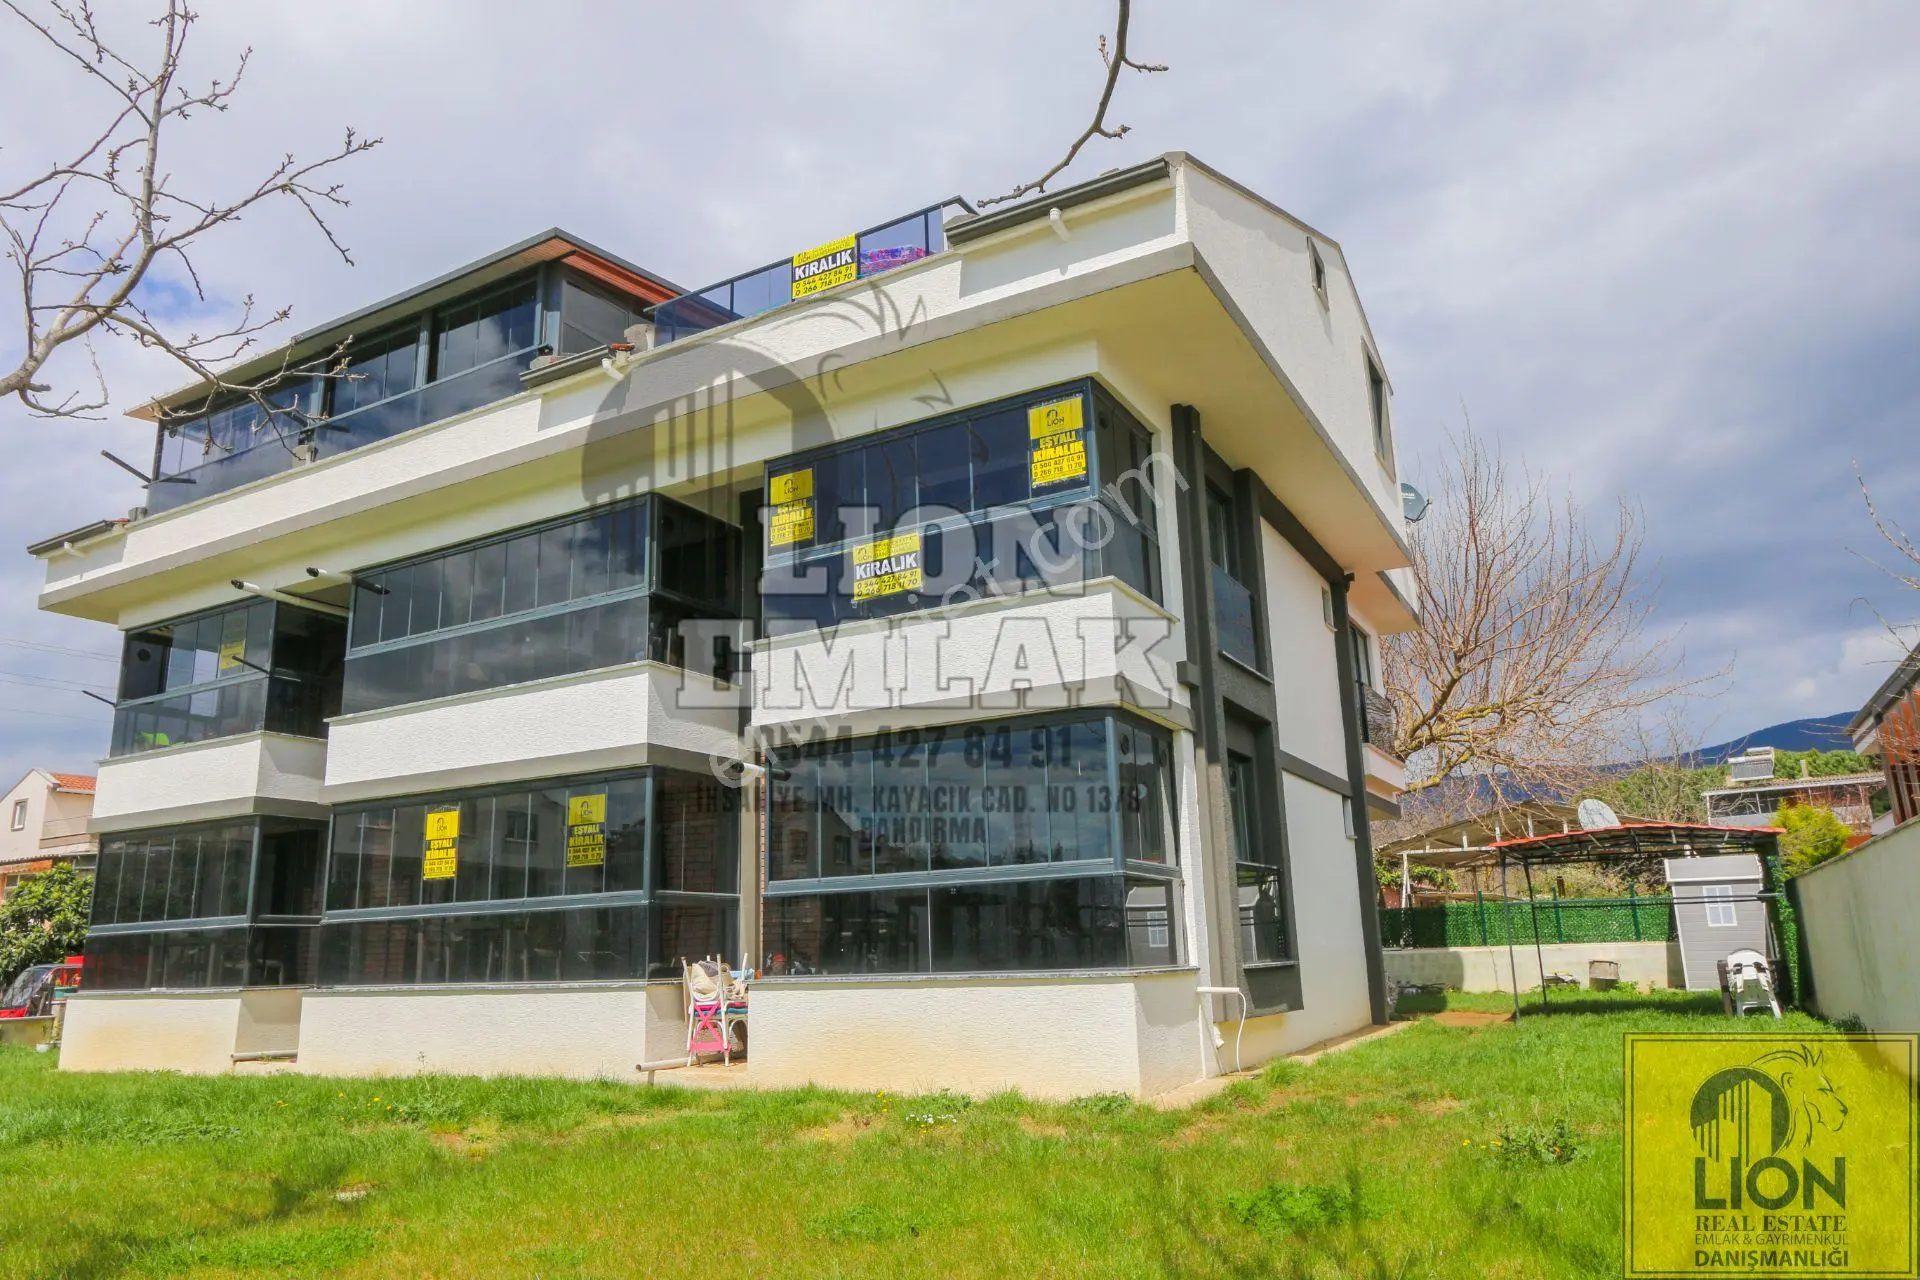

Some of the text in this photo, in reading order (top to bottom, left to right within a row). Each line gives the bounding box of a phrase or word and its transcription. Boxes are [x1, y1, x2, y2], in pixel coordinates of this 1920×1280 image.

[819, 273, 832, 281] 427
[833, 269, 842, 277] 84
[820, 279, 832, 289] 718
[843, 272, 853, 281] 70
[884, 582, 896, 591] 718
